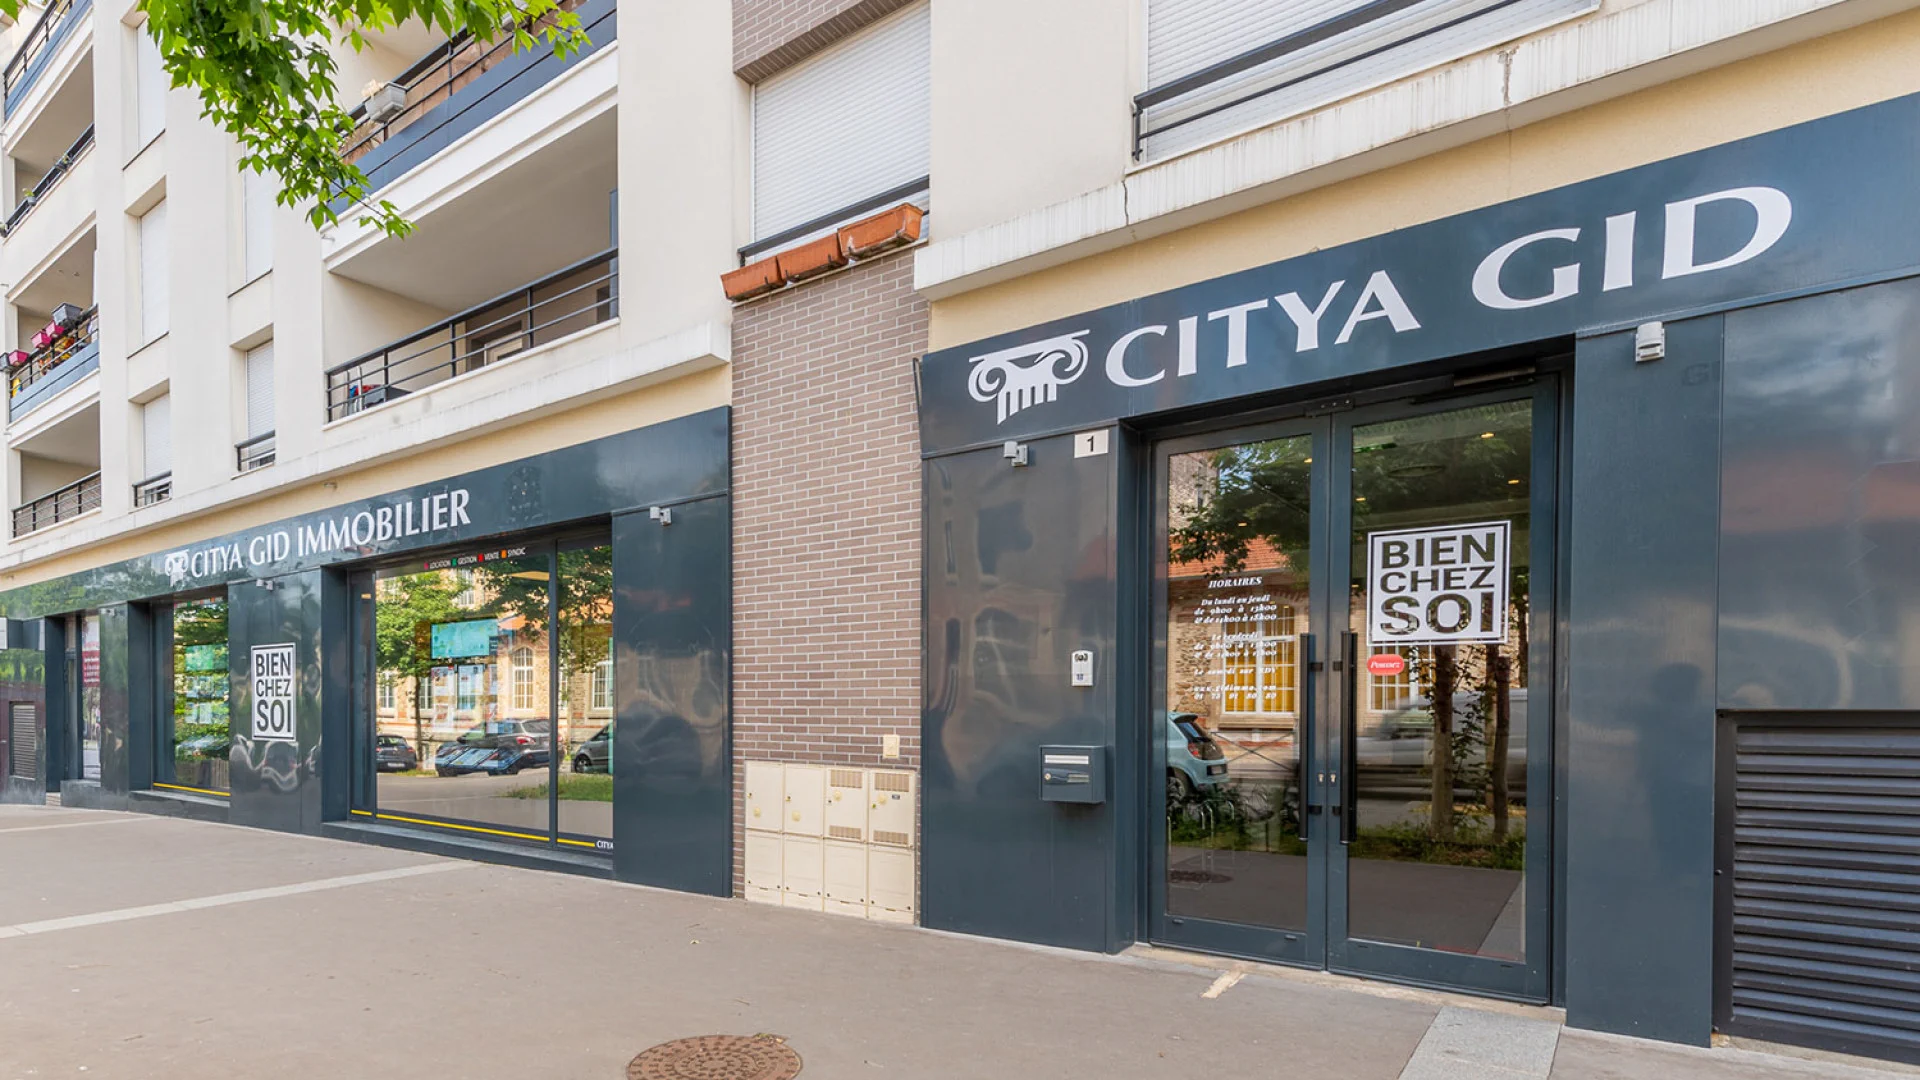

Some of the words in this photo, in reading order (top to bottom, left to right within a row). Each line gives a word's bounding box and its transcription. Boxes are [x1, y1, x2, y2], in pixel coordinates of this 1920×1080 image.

[1105, 269, 1422, 386] CITYA
[1472, 186, 1793, 310] GID
[1087, 435, 1094, 452] 1
[191, 543, 243, 579] CITYA
[248, 529, 291, 566] GID
[297, 488, 472, 557] IMMOBILIER
[1381, 532, 1496, 569] BIEN
[1208, 577, 1262, 588] HORAIRES
[1379, 565, 1495, 594] CHEZ
[1380, 592, 1494, 636] SOI
[255, 651, 292, 677] BIEN
[255, 678, 292, 697] CHEZ
[256, 699, 292, 733] SOI
